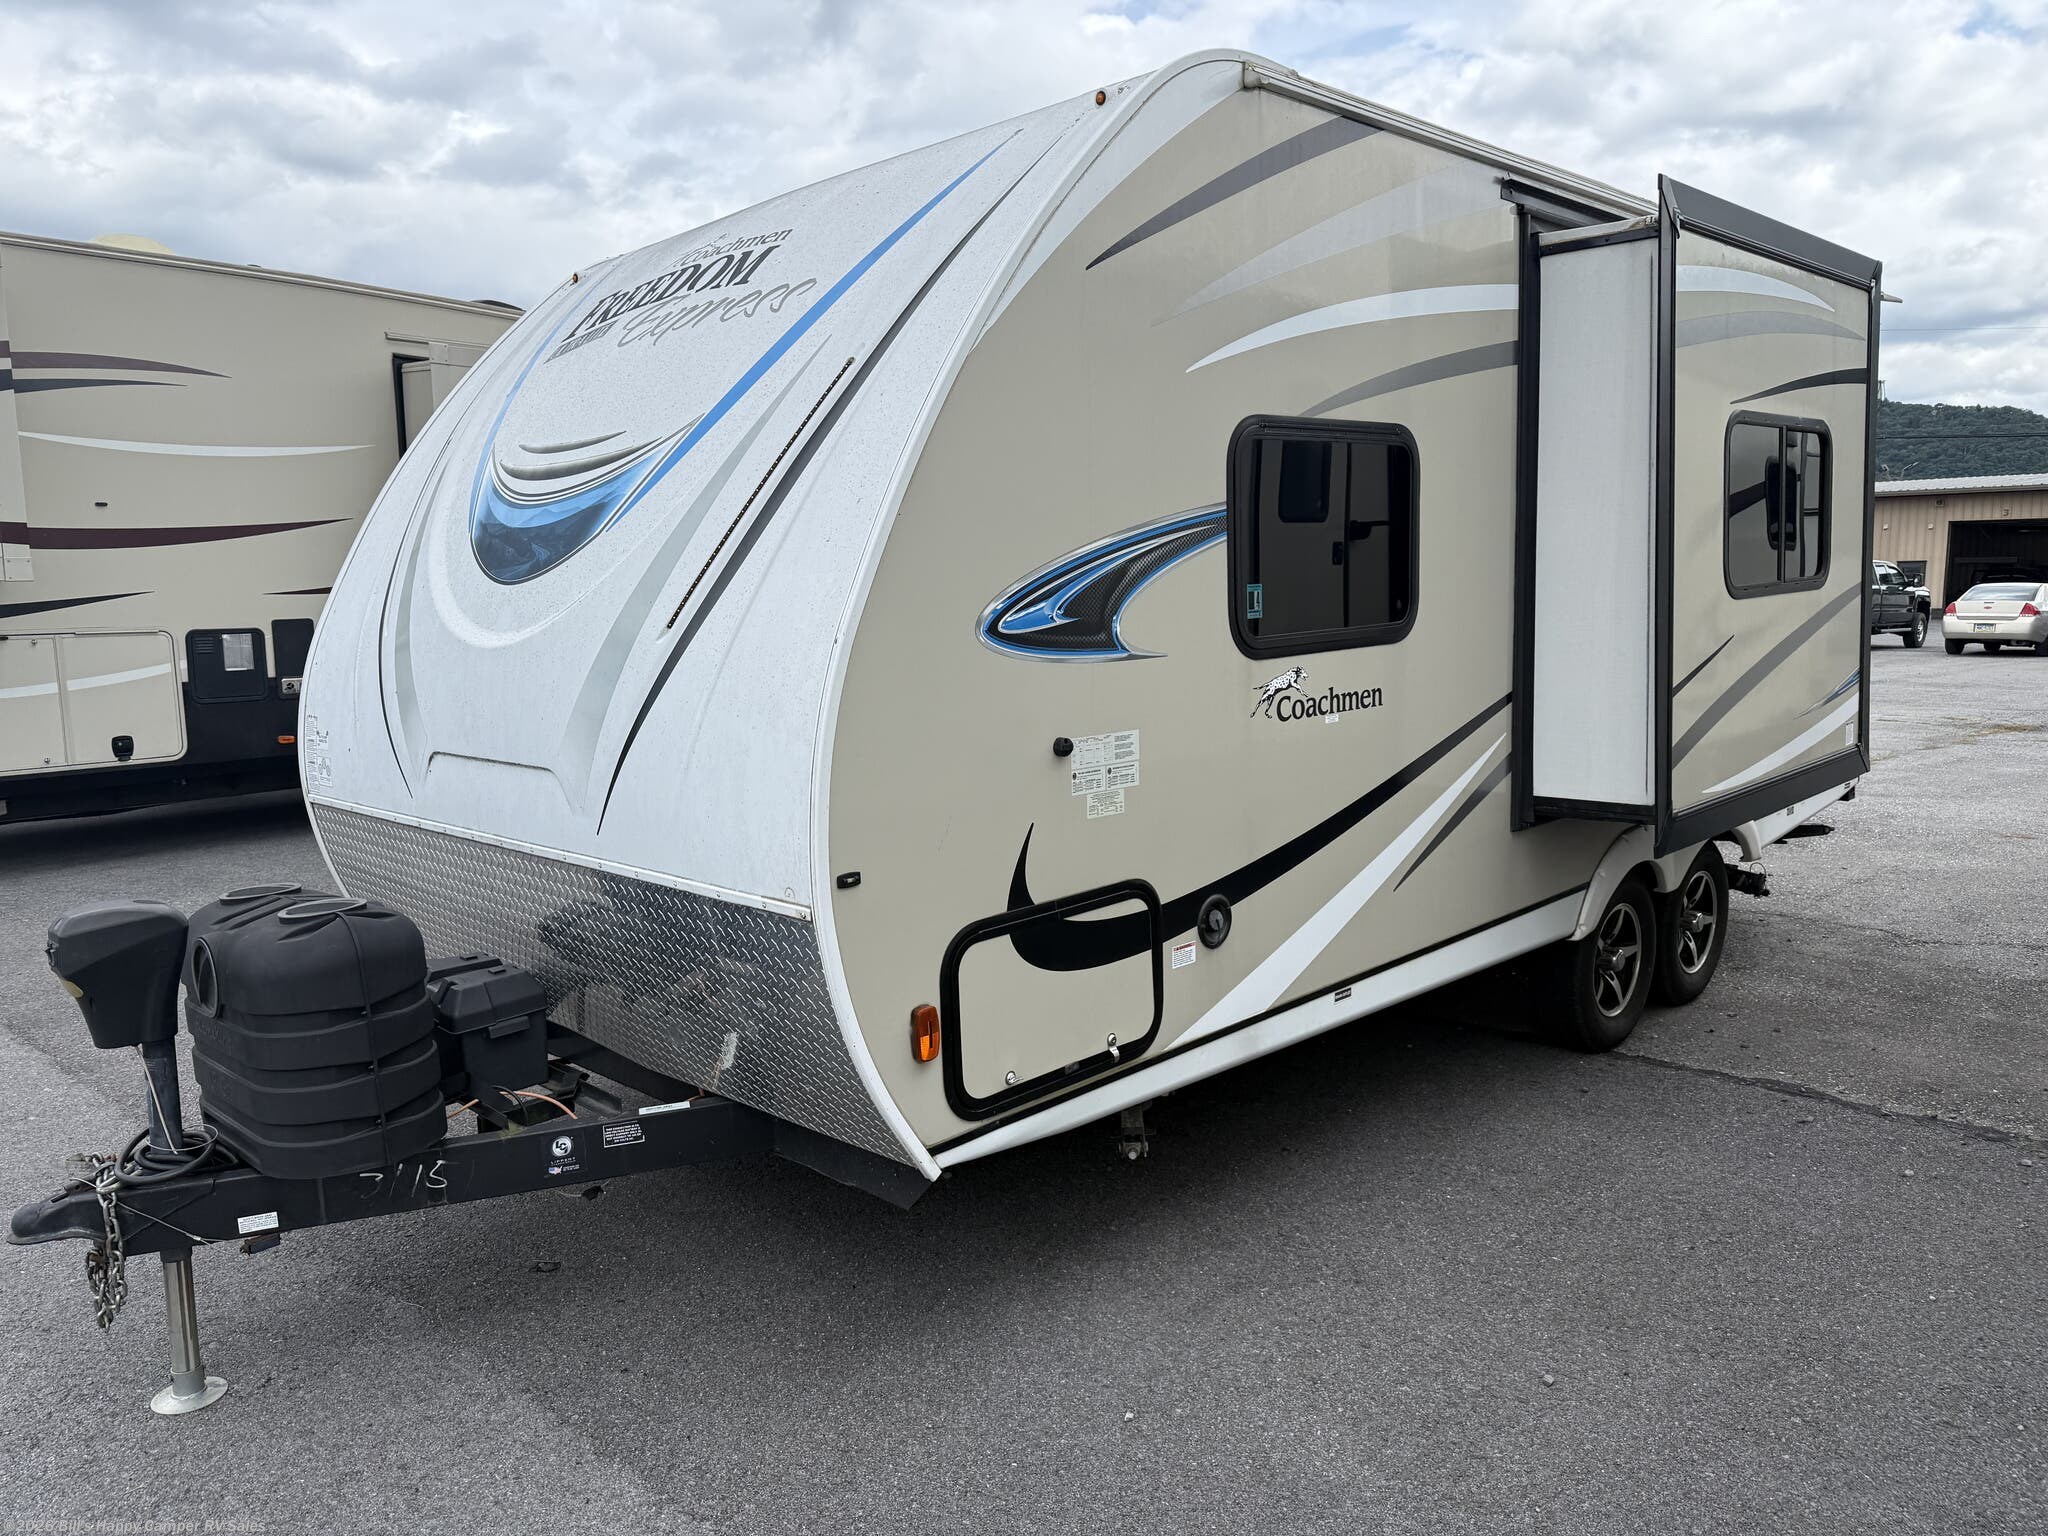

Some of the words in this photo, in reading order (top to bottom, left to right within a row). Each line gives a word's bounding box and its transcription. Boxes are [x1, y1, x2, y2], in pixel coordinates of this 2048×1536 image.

[680, 228, 793, 267] Coachmen
[561, 244, 781, 343] FREEDOM
[616, 277, 818, 348] Express
[1276, 686, 1383, 722] Coachmen
